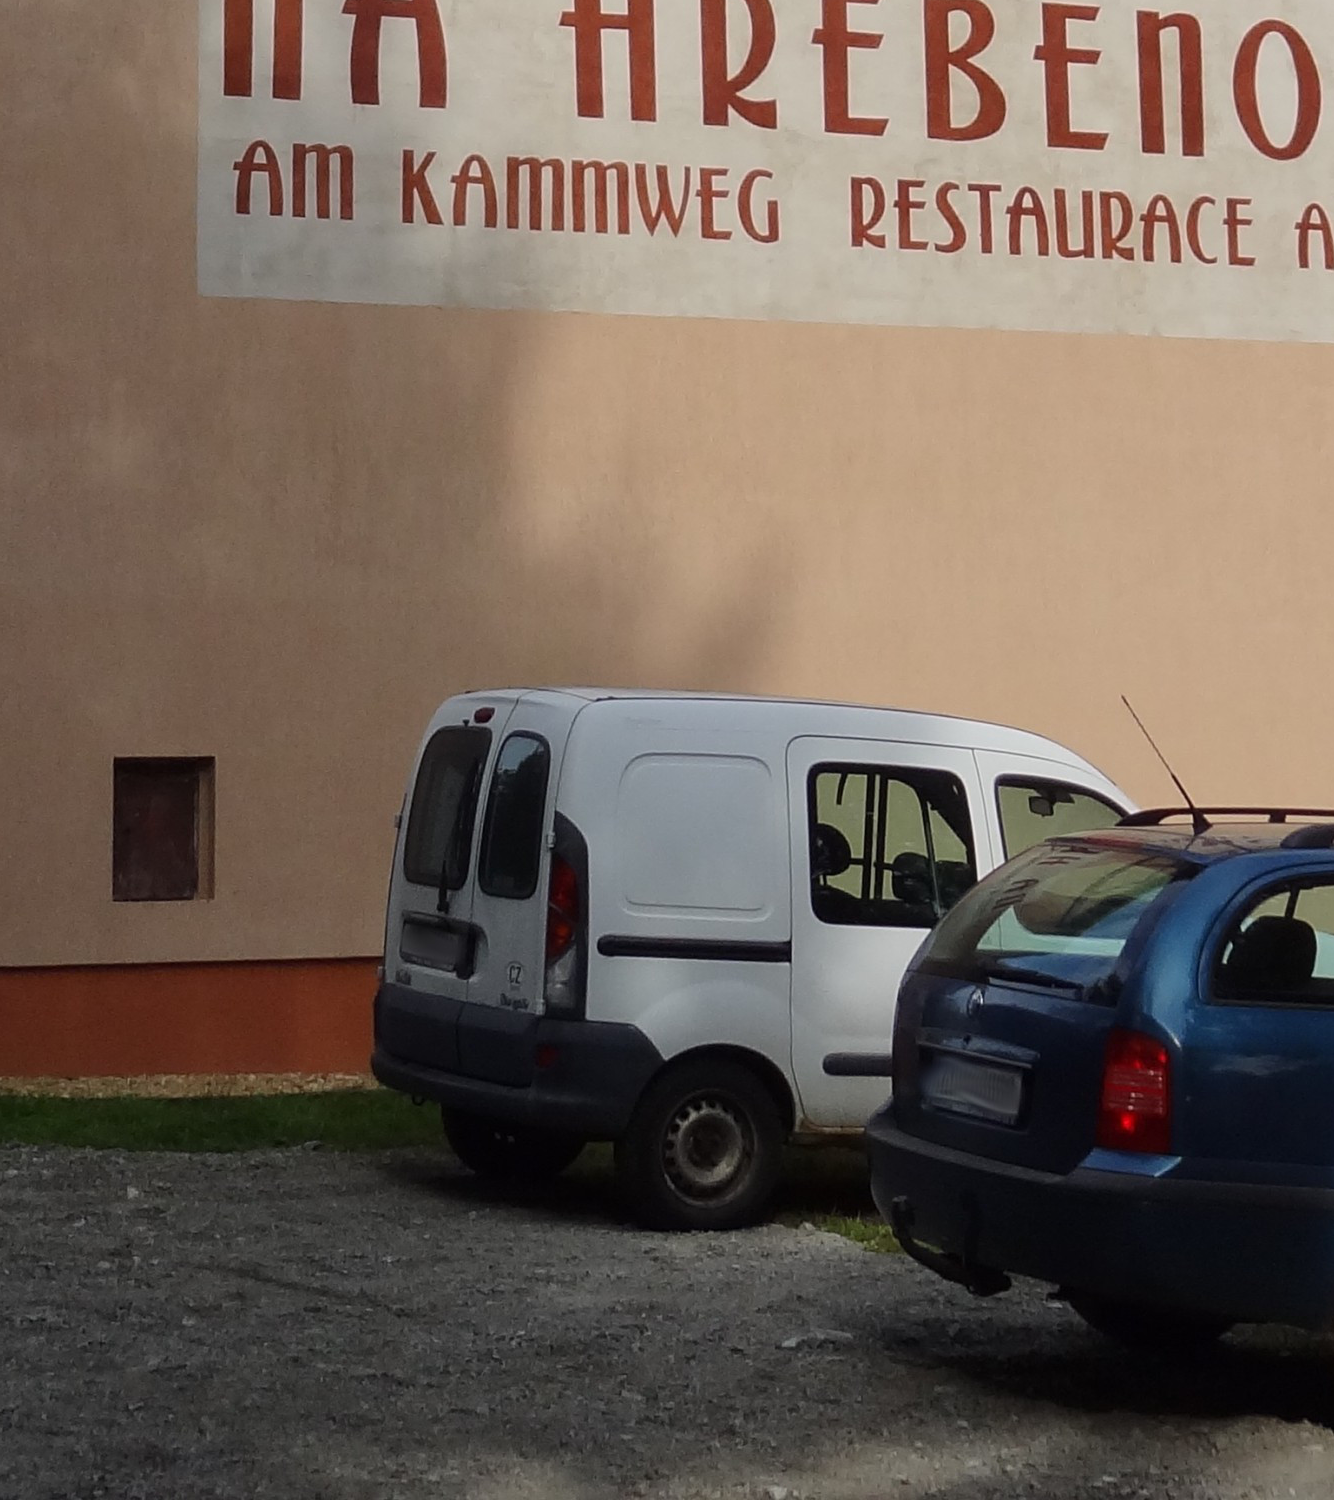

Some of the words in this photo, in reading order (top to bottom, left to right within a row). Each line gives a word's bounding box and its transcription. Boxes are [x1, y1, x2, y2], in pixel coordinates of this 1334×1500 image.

[233, 139, 355, 221] AM
[402, 148, 781, 244] KAMMWEG
[850, 176, 1257, 268] RESTAURACE
